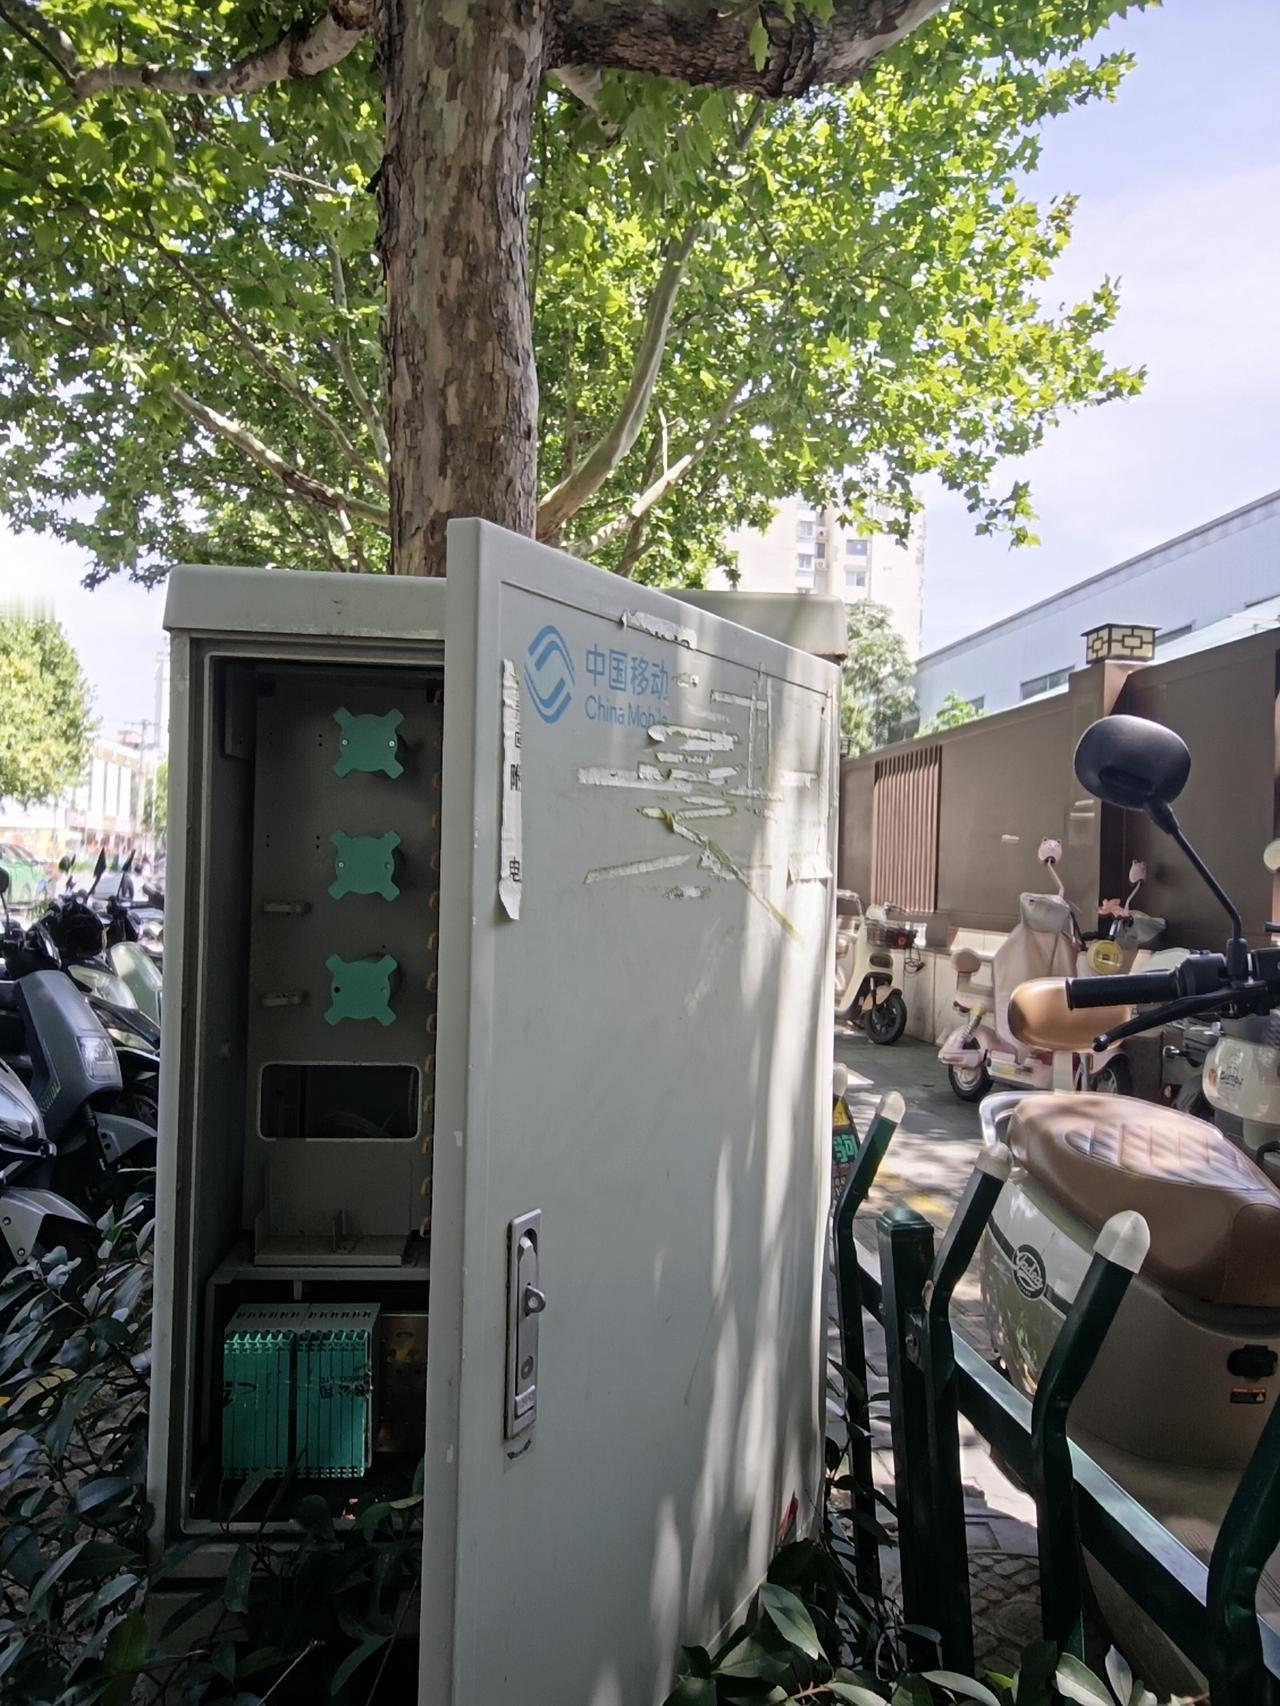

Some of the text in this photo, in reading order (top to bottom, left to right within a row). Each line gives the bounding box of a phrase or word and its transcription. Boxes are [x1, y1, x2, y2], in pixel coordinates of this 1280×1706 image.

[586, 643, 669, 700] 中国移动
[585, 694, 669, 729] China Moble
